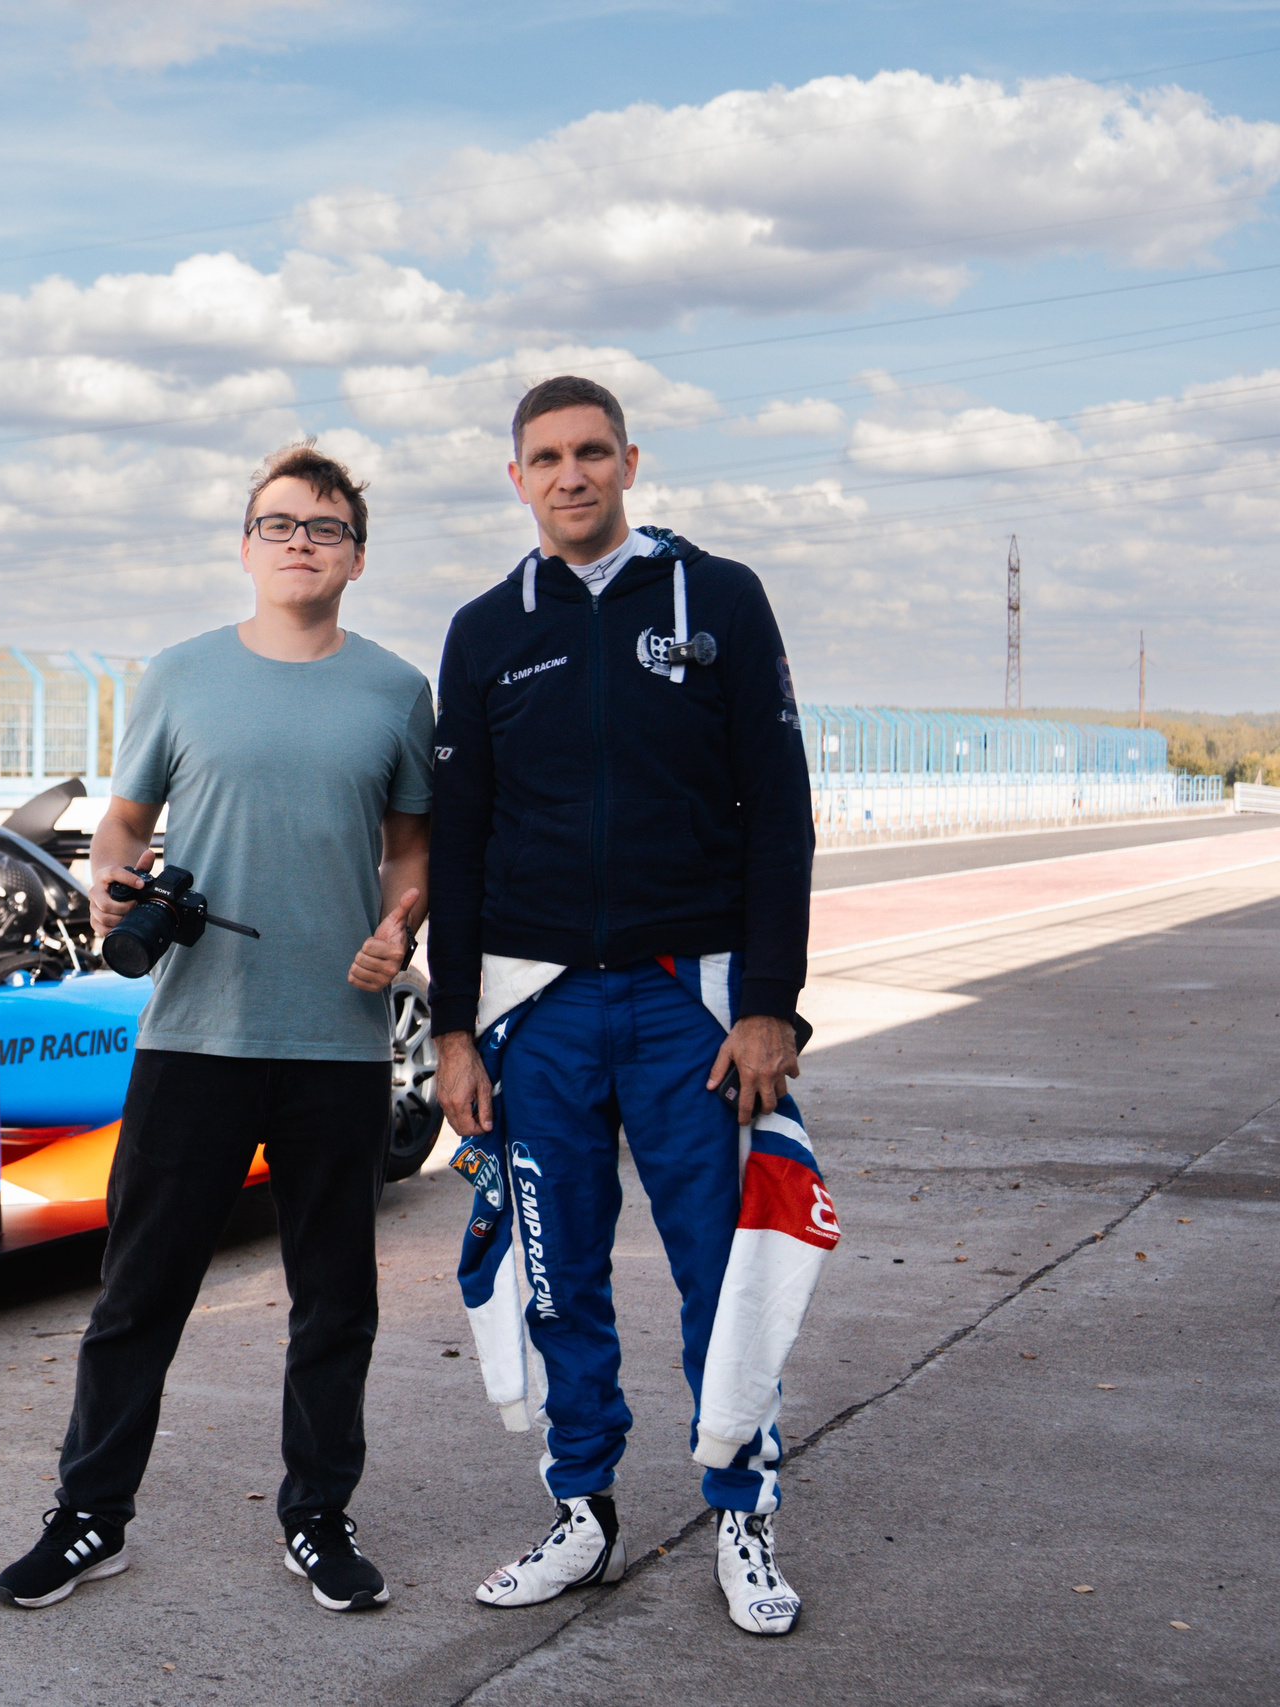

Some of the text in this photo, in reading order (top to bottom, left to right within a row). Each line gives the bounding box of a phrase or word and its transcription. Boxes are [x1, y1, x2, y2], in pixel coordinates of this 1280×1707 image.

[512, 656, 568, 681] SMP RACING
[153, 886, 171, 896] SONY
[39, 1026, 128, 1062] RACING
[518, 1177, 542, 1237] SMP
